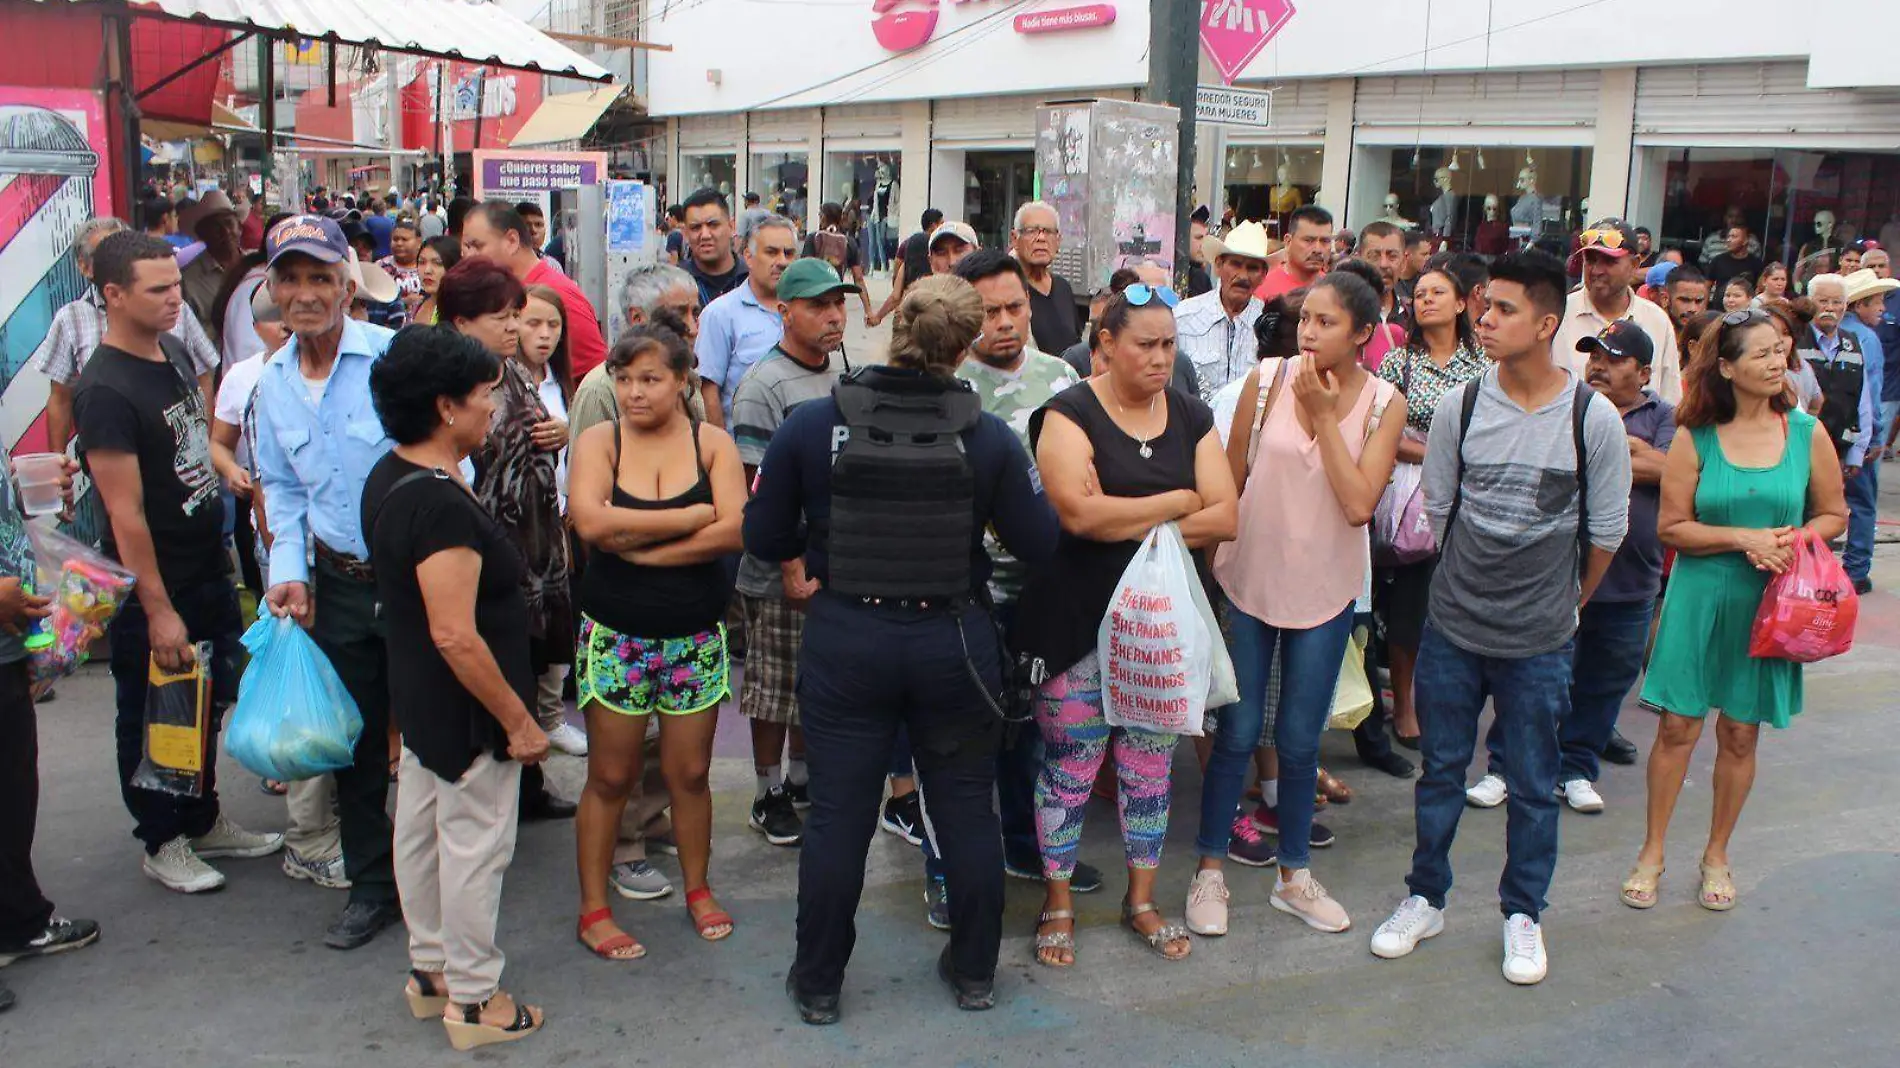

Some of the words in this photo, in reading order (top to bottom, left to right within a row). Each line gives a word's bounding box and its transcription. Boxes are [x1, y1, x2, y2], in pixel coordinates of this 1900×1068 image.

[1021, 16, 1040, 28] Nadie
[1041, 14, 1058, 27] tiene
[1197, 92, 1231, 105] RREDOR
[1233, 95, 1266, 108] SEGURO
[1219, 107, 1257, 121] MUJERES
[500, 161, 548, 173] ¿Quieres
[550, 162, 581, 174] saber
[500, 176, 520, 188] que
